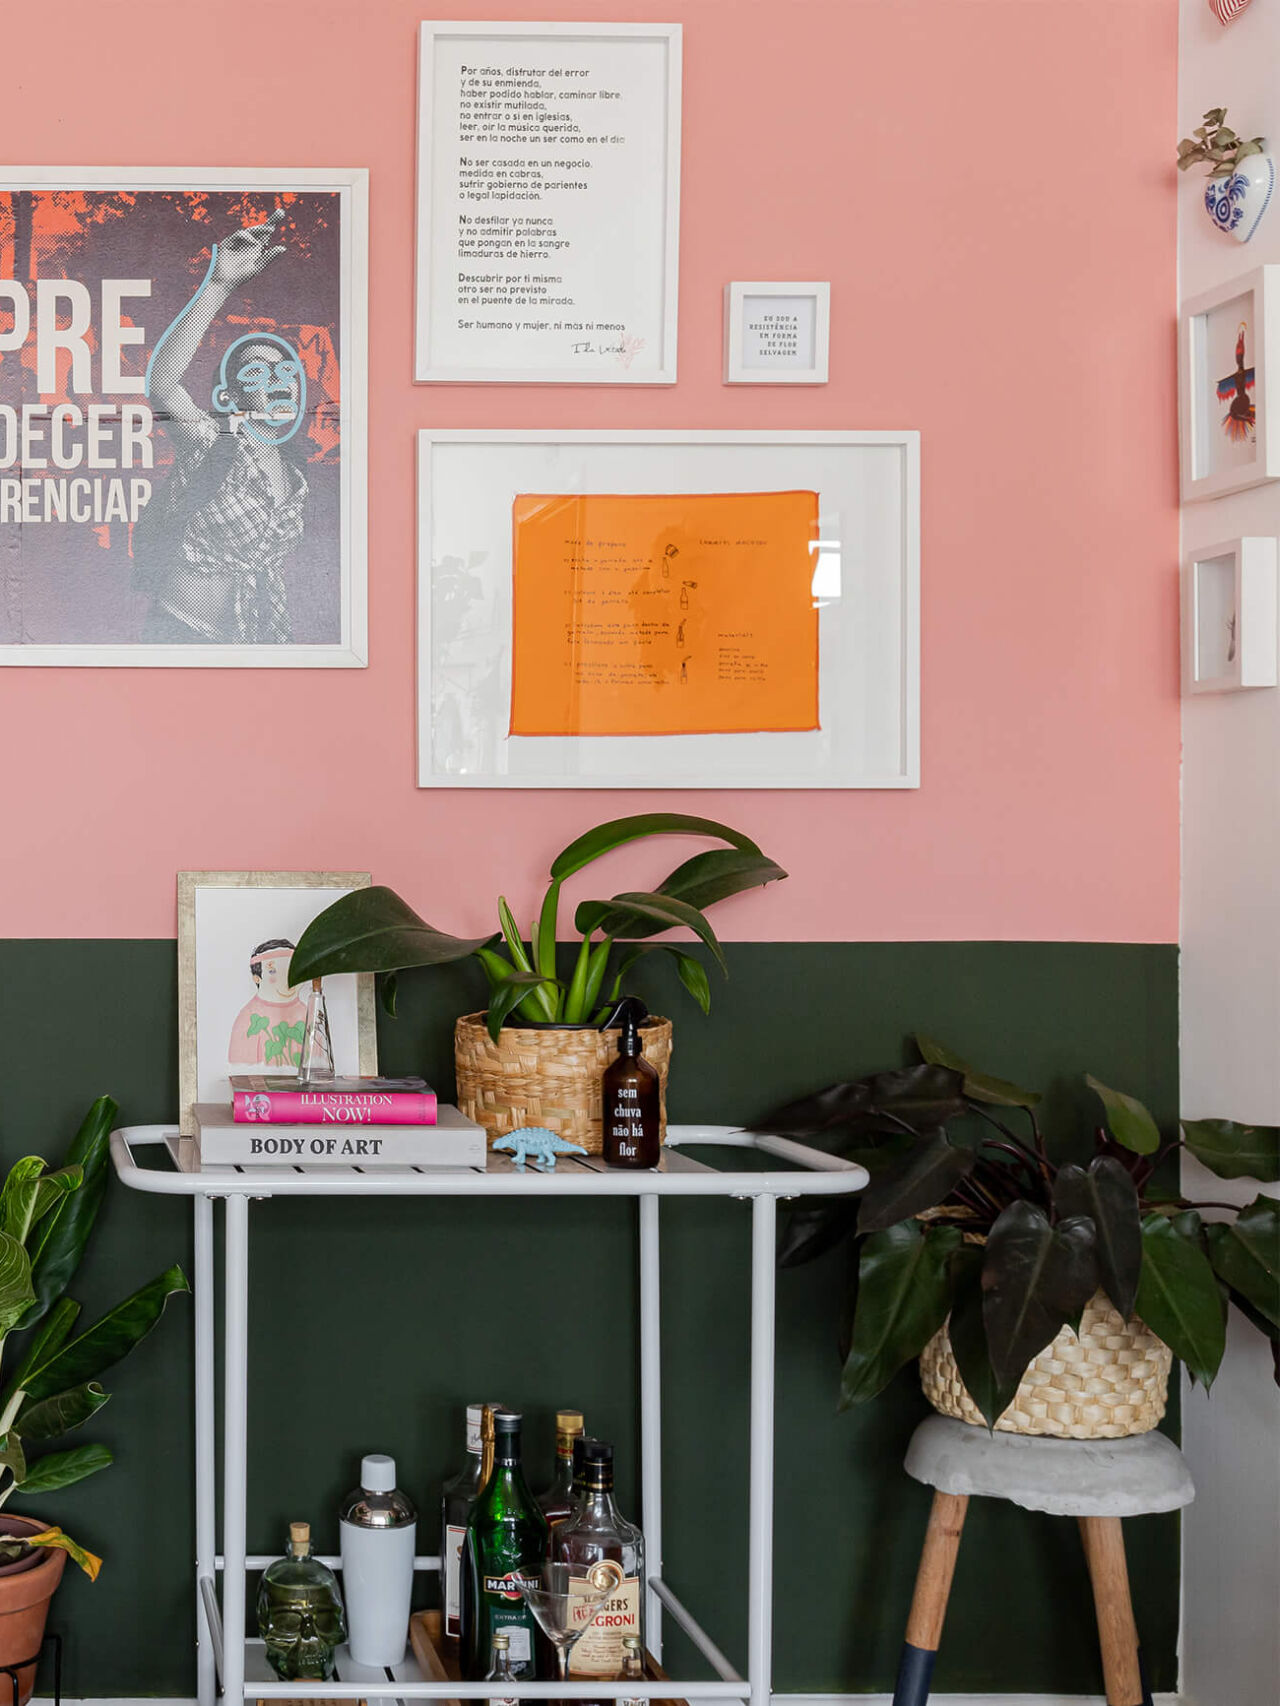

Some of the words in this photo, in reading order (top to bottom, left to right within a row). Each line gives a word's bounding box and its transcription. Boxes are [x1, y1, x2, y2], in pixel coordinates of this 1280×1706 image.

[460, 66, 478, 76] Por
[505, 67, 546, 77] disfrutar
[547, 67, 563, 77] del
[564, 69, 589, 77] error
[468, 78, 480, 88] de
[482, 80, 493, 88] su
[494, 78, 542, 91] enmienda,
[460, 88, 488, 98] haber
[489, 89, 522, 101] podido
[523, 89, 559, 102] hablar,
[558, 90, 596, 100] caminar
[459, 101, 472, 109] no
[473, 100, 502, 110] existir
[503, 100, 547, 112] mutilada,
[459, 112, 472, 121] no
[473, 111, 502, 121] entrar
[522, 113, 534, 121] en
[535, 112, 573, 124] iglesias,
[496, 122, 507, 132] la
[541, 123, 581, 136] querida,
[459, 135, 475, 143] ser
[476, 135, 488, 143] en
[489, 133, 499, 143] la
[499, 134, 528, 144] noche
[529, 136, 542, 144] un
[542, 136, 559, 144] ser
[559, 136, 585, 144] como
[586, 137, 598, 145] en
[600, 135, 609, 145] el
[459, 157, 474, 167] No
[474, 159, 491, 167] ser
[491, 157, 526, 167] casada
[526, 159, 540, 168] en
[540, 160, 553, 168] un
[458, 168, 495, 178] medida
[495, 170, 508, 179] en
[508, 169, 546, 181] cabras,
[458, 179, 486, 189] sufrir
[486, 180, 529, 192] gobierno
[529, 180, 543, 190] de
[543, 180, 588, 193] parientes
[466, 191, 491, 203] legal
[458, 215, 473, 225] No
[474, 216, 510, 226] desfilar
[511, 218, 524, 228] ya
[525, 218, 554, 226] nunca
[465, 228, 480, 236] no
[479, 227, 516, 237] admitir
[515, 227, 558, 239] palabras
[458, 239, 476, 250] que
[477, 240, 513, 250] pongan
[514, 240, 526, 248] en
[527, 238, 537, 248] la
[538, 241, 570, 251] sangre
[457, 249, 505, 259] limaduras
[505, 249, 519, 259] de
[458, 273, 503, 283] Descubrir
[505, 276, 521, 286] por
[523, 274, 531, 284] ti
[532, 274, 562, 284] misma
[457, 284, 478, 294] otro
[478, 286, 495, 294] ser
[495, 286, 508, 295] no
[509, 285, 547, 297] previsto
[457, 297, 470, 305] en
[471, 295, 480, 305] el
[481, 295, 513, 308] puente
[514, 296, 527, 306] de
[528, 296, 538, 306] la
[457, 319, 475, 329] Ser
[475, 320, 513, 330] humano
[553, 320, 563, 330] ni
[585, 321, 594, 331] ni
[617, 1088, 637, 1098] sem
[301, 1094, 393, 1106] ILLUSTRATION
[322, 1107, 373, 1122] NOW!
[614, 1104, 642, 1118] chuva
[612, 1125, 629, 1137] não
[632, 1123, 644, 1137] há
[250, 1138, 305, 1154] BODY
[310, 1139, 338, 1154] OF
[341, 1139, 383, 1155] ART
[619, 1142, 637, 1156] flor
